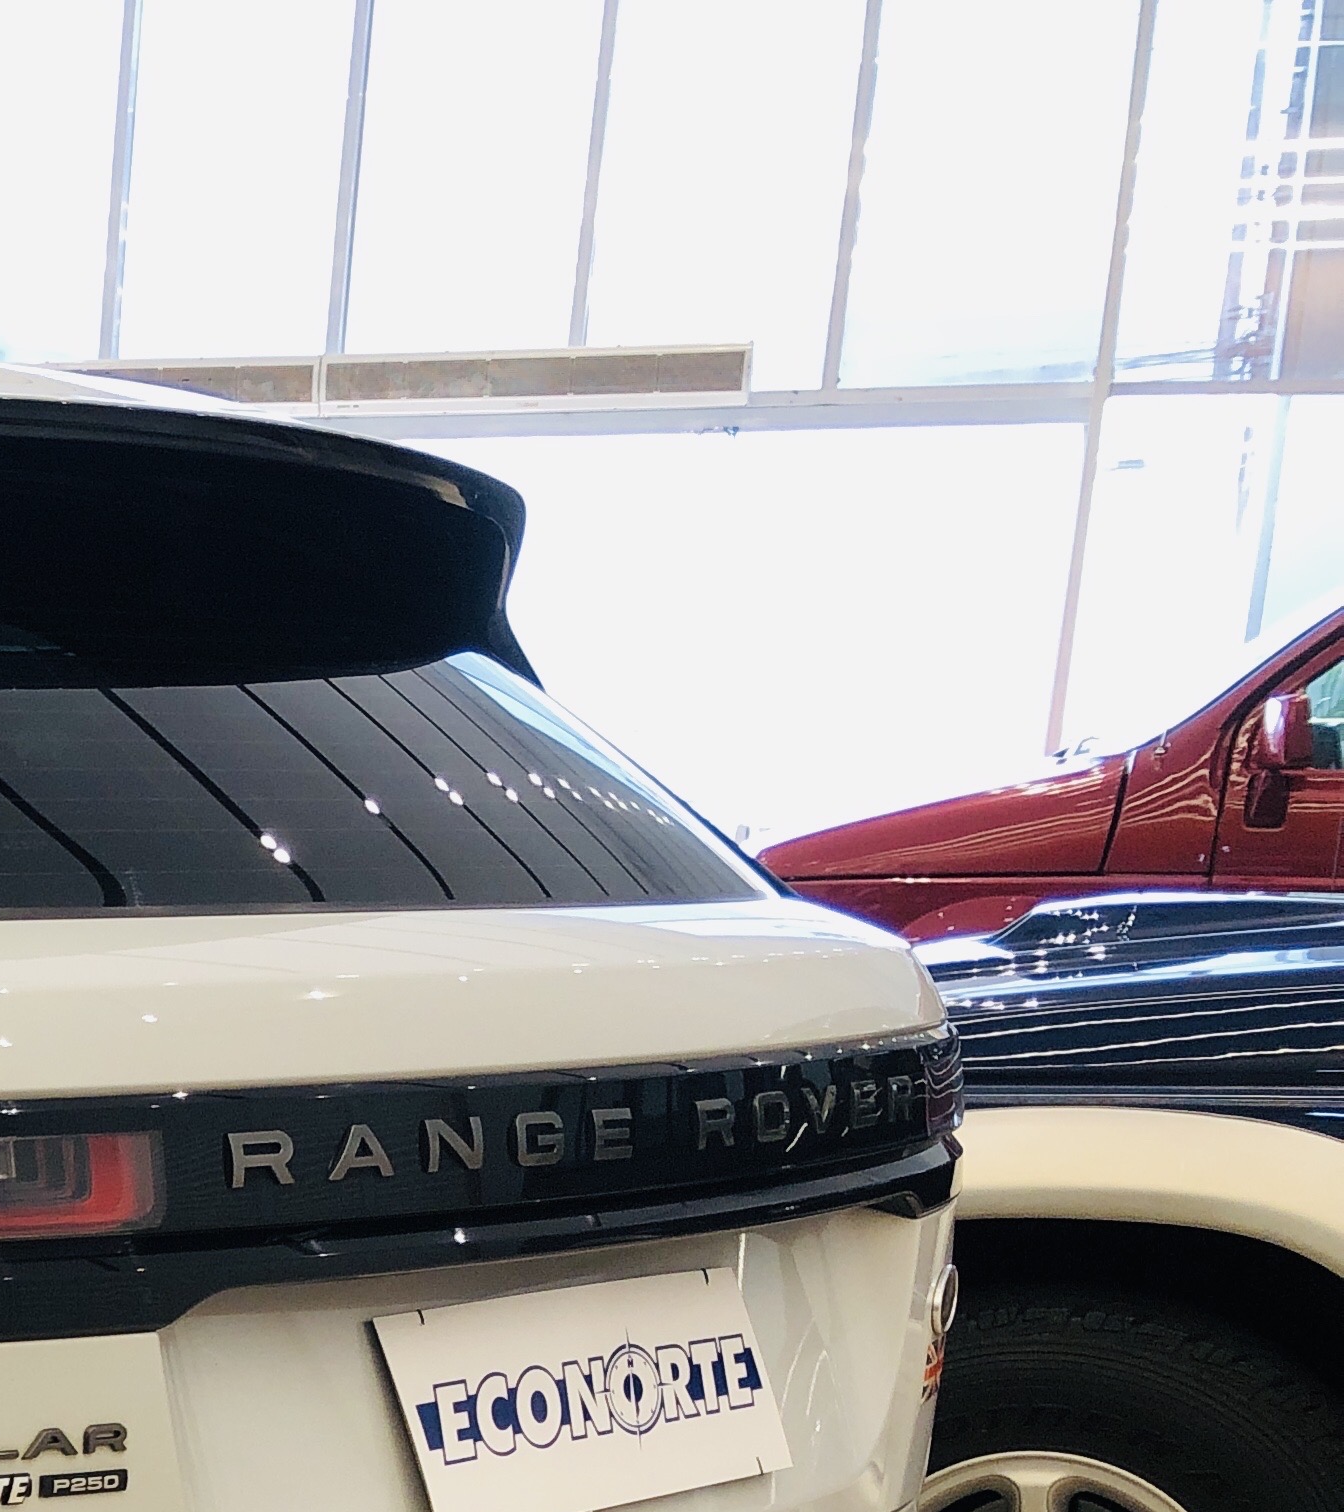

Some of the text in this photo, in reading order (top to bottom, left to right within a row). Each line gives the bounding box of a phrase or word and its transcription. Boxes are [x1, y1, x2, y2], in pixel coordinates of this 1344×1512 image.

[224, 1073, 915, 1189] RANGE ROVER
[430, 1332, 756, 1466] ECONORTE
[52, 1474, 121, 1494] P250
